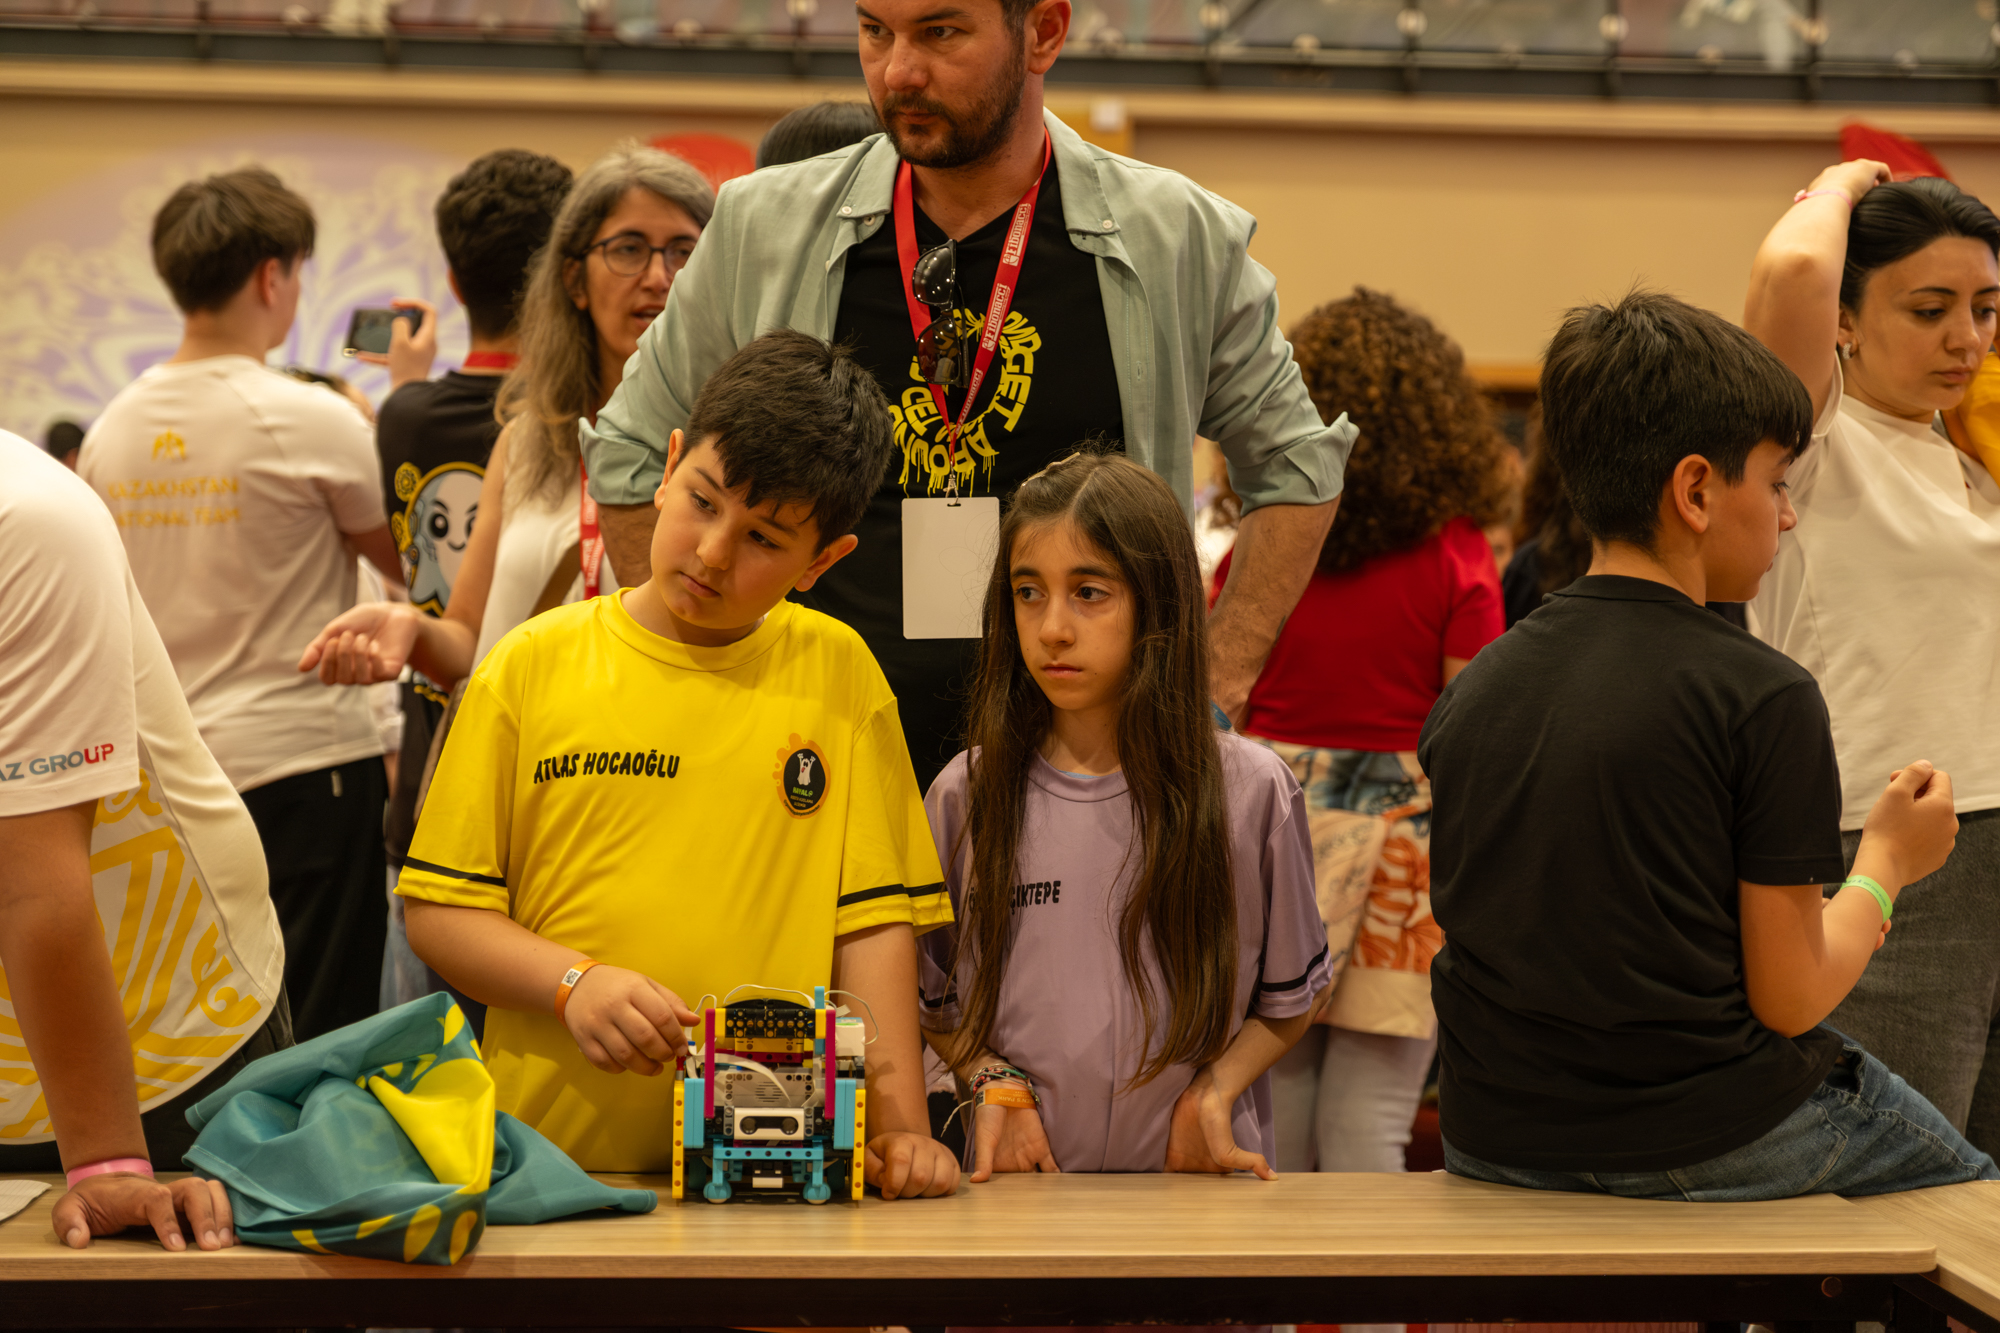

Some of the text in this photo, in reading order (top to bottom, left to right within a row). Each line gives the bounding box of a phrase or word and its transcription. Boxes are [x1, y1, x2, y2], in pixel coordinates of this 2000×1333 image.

[1006, 203, 1029, 255] Fibonacci
[986, 283, 1008, 342] Fibonacci
[29, 743, 114, 776] GROUP
[533, 748, 680, 784] ATLAS HOCAOĞLU
